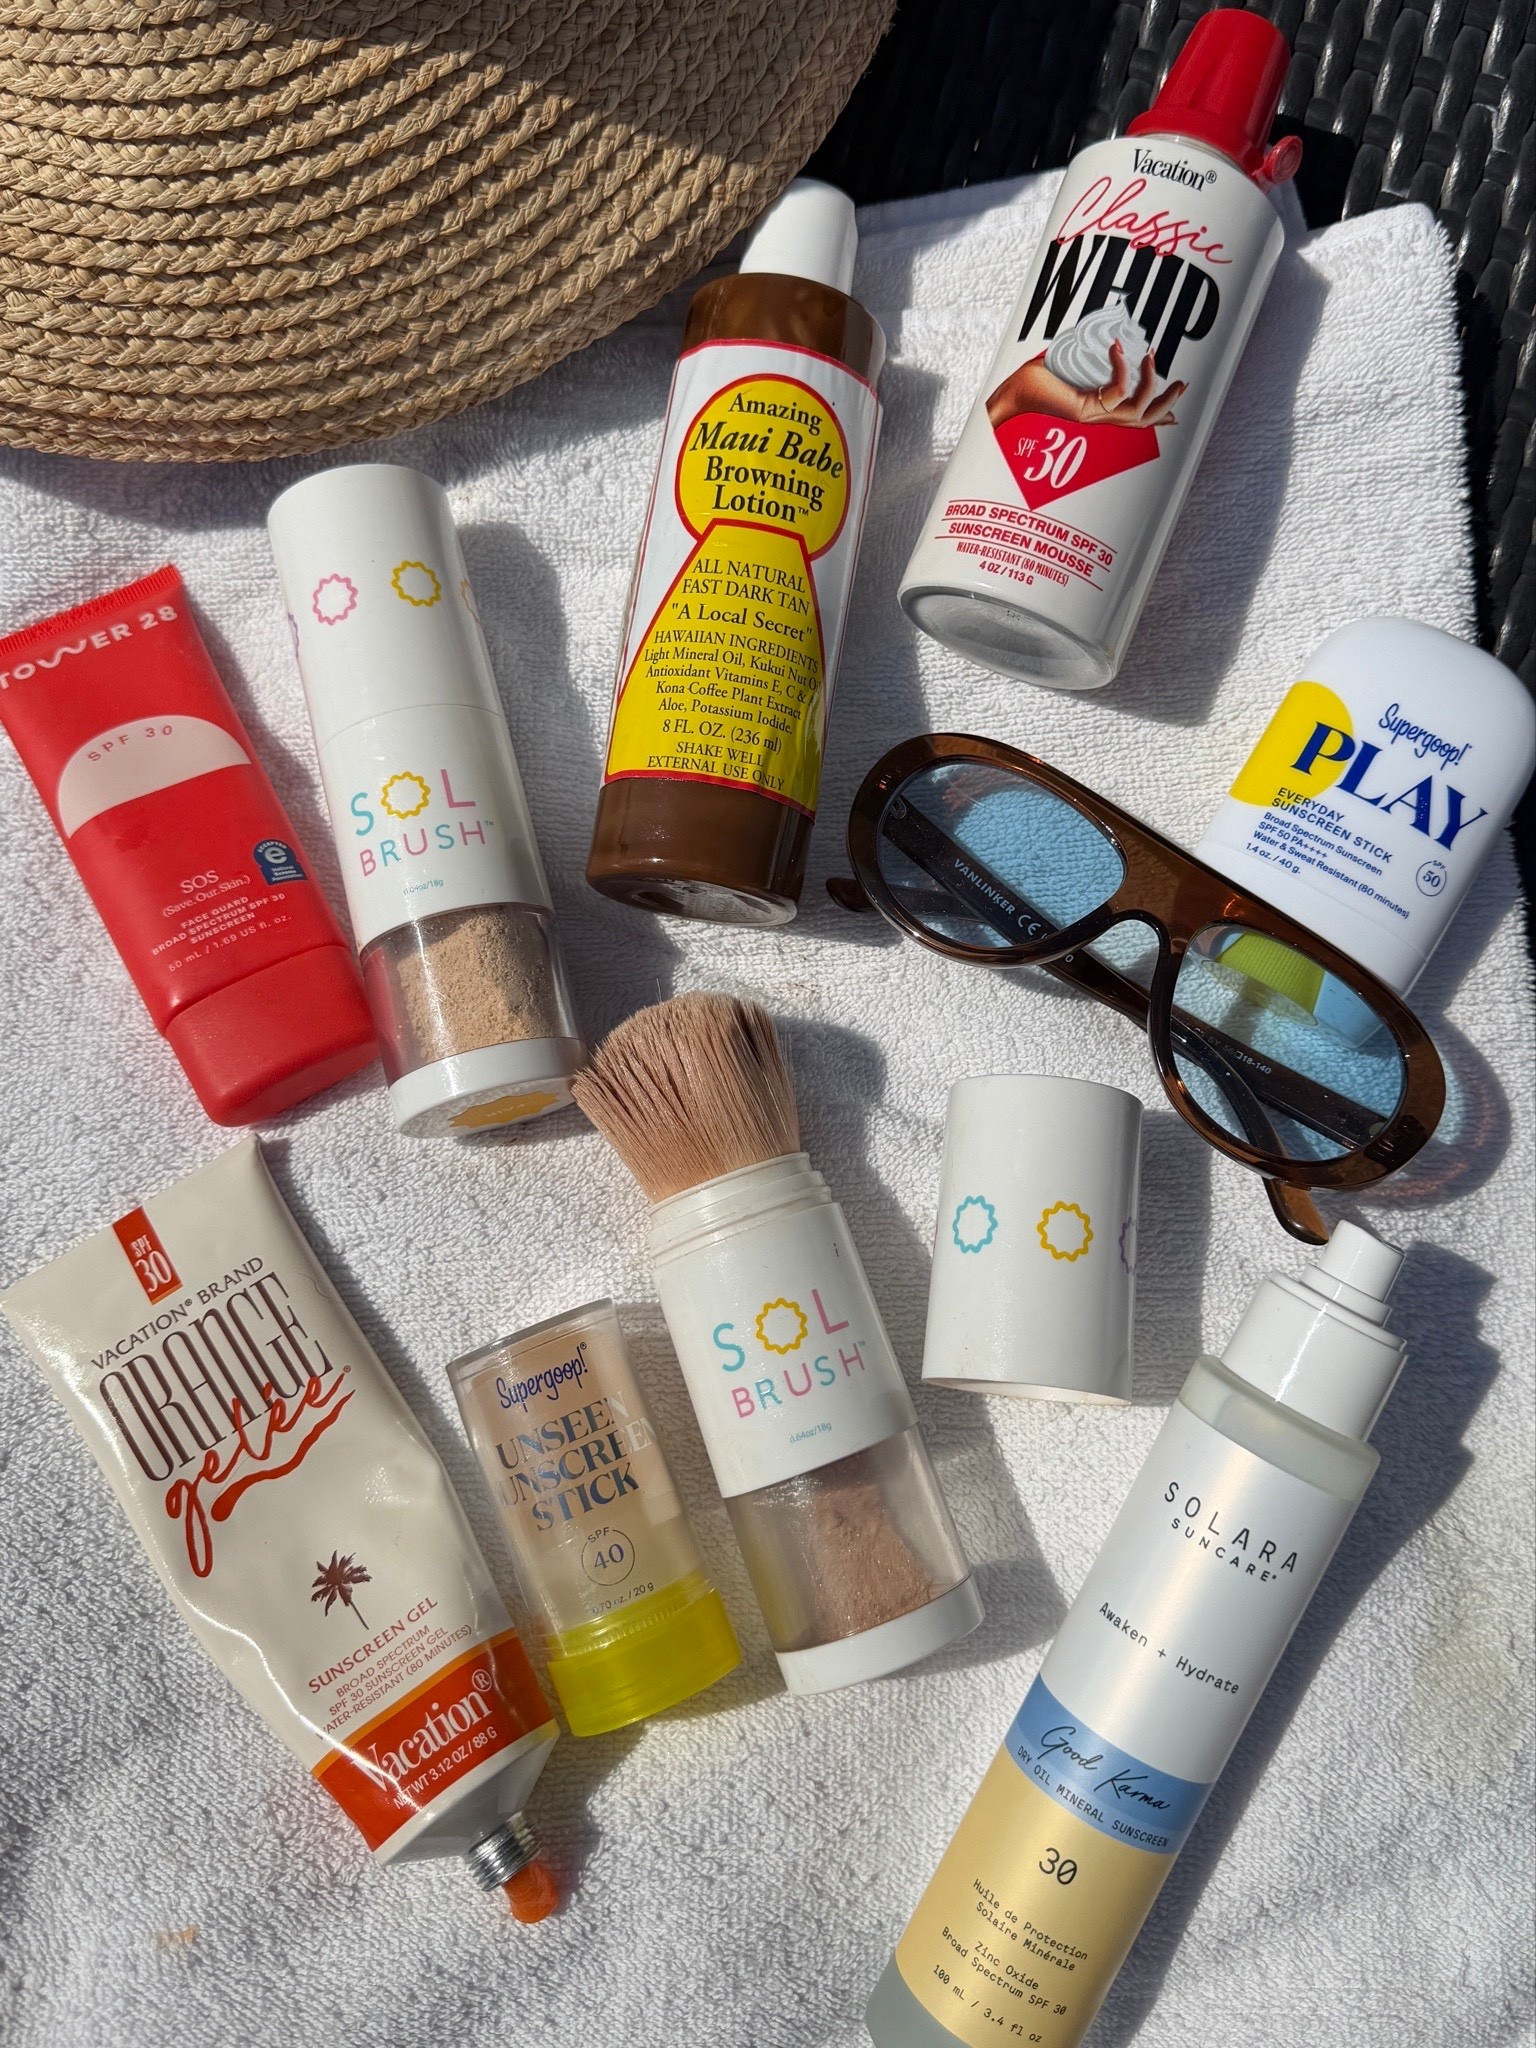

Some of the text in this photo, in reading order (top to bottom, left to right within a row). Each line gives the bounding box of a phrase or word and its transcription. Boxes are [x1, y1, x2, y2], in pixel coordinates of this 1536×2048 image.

[1056, 176, 1233, 264] Classic
[1017, 234, 1220, 380] WHIP
[728, 392, 823, 436] Amazing
[689, 421, 844, 479] Maui Babe
[1014, 428, 1088, 489] SPF 30
[704, 456, 825, 512] Browning
[944, 504, 1114, 566] BROAD SPECTRUM SPF 30
[948, 522, 1095, 577] SUNSCREEN MOUSSE
[692, 558, 806, 594] ALL NATURAL
[956, 541, 1070, 587] WATER-RESISTANT (80 MINUTES)
[1008, 568, 1026, 583] 113
[681, 579, 810, 616] FAST DARK TAN
[697, 604, 813, 643] Local Secret"
[0, 605, 178, 690] TOWER 28
[644, 646, 806, 686] Light Mineral Oil, Kukui Nut
[654, 630, 819, 674] HAWAIIAN INGREDIENTS
[646, 665, 769, 690] Antioxidant Vitamins
[656, 681, 685, 694] Kona
[689, 681, 728, 698] Coffee
[731, 687, 762, 707] Plant
[765, 695, 802, 720] Extract
[88, 725, 173, 761] SPF 30
[658, 697, 793, 735] Aloe, Potassium Iodide.
[662, 719, 783, 754] 8 FL. OZ. (236 ml)
[647, 755, 785, 792] EXTERNAL USE ONLY
[676, 741, 764, 766] SHAKE WELL
[351, 769, 476, 836] SOL
[1277, 787, 1345, 823] EVERYDAY
[1290, 721, 1489, 851] PLAY
[1258, 821, 1329, 859] SPF 50 PA++++
[1263, 812, 1383, 876] Broad Spectrum Sunscreen
[1271, 797, 1394, 864] SUNSCREEN STICK
[180, 870, 219, 894] SOS
[1252, 830, 1410, 919] Water Sweat Resistant (80 minutes)
[1278, 856, 1293, 869] 40
[1422, 870, 1441, 888] 50
[182, 896, 249, 929] FACE GUARD
[953, 858, 1042, 936] VANLINKER CE
[152, 897, 270, 956] BROAD SPECTRUM SPF
[190, 912, 256, 944] SUNSCREEN
[169, 960, 183, 972] 50
[130, 1234, 152, 1258] SPF
[134, 1250, 173, 1293] 30
[196, 1256, 264, 1306] BRAND
[712, 1288, 850, 1373] SOL
[97, 1271, 334, 1482] ORANGE
[495, 1390, 630, 1470] UNSEEN
[789, 1422, 833, 1444] 0.64oz/18g
[495, 1417, 657, 1508] UNSCREEN
[531, 1461, 640, 1532] STICK
[587, 1526, 611, 1544] SPF
[1164, 1482, 1298, 1573] SOLARA
[593, 1542, 625, 1570] 40
[633, 1584, 646, 1596] 20
[308, 1596, 438, 1694] SUNSCREEN GEL
[328, 1626, 449, 1717] SPF 30 SUNSCREEN GEL
[336, 1625, 431, 1698] BROAD SPECTRUM
[406, 1660, 425, 1677] (80
[425, 1623, 473, 1660] MINUTES)
[1099, 1602, 1240, 1694] Awaken Hydrate
[412, 1732, 488, 1794] WT 3.12 OZ 88
[1037, 1725, 1171, 1810] Good Karma
[1017, 1745, 1170, 1847] DRY OIL MINERAL SUNSCREEN
[1038, 1847, 1078, 1885] 30
[973, 1878, 1089, 1961] Huile de Protection
[976, 1901, 1077, 1972] Solaire Minérale
[942, 1926, 1067, 2015] Broad Spectrum SPF 30
[974, 1940, 1039, 1990] Zinc Oxide
[933, 1964, 1043, 2043] 100 mL 3.4 fl oz
